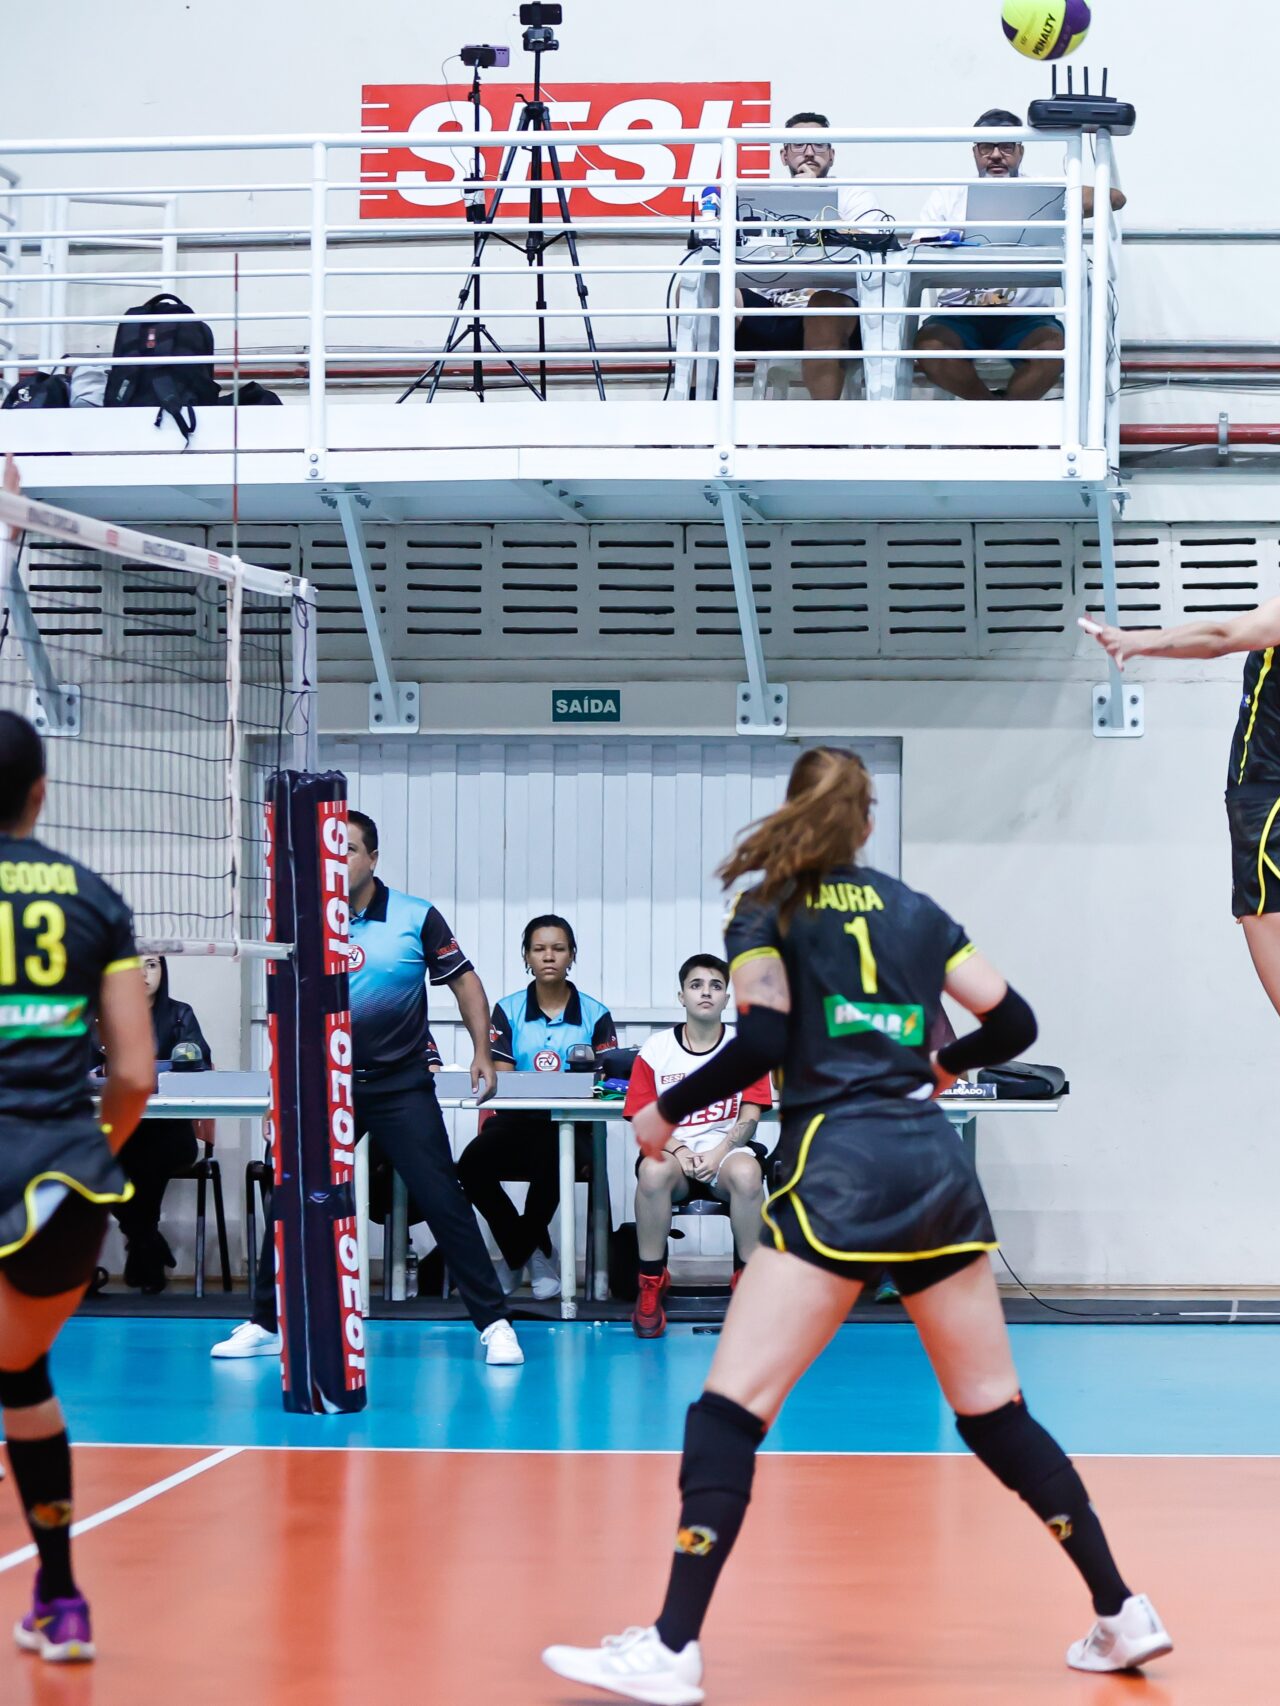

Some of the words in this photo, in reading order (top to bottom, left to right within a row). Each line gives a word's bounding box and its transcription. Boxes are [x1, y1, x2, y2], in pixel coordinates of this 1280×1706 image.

[1031, 13, 1056, 56] PENALTY
[396, 98, 734, 206] SESI
[555, 695, 617, 714] SAÍDA
[0, 861, 78, 895] GODOI
[0, 900, 67, 986] 13
[843, 916, 878, 994] 1
[662, 1074, 685, 1085] SESI
